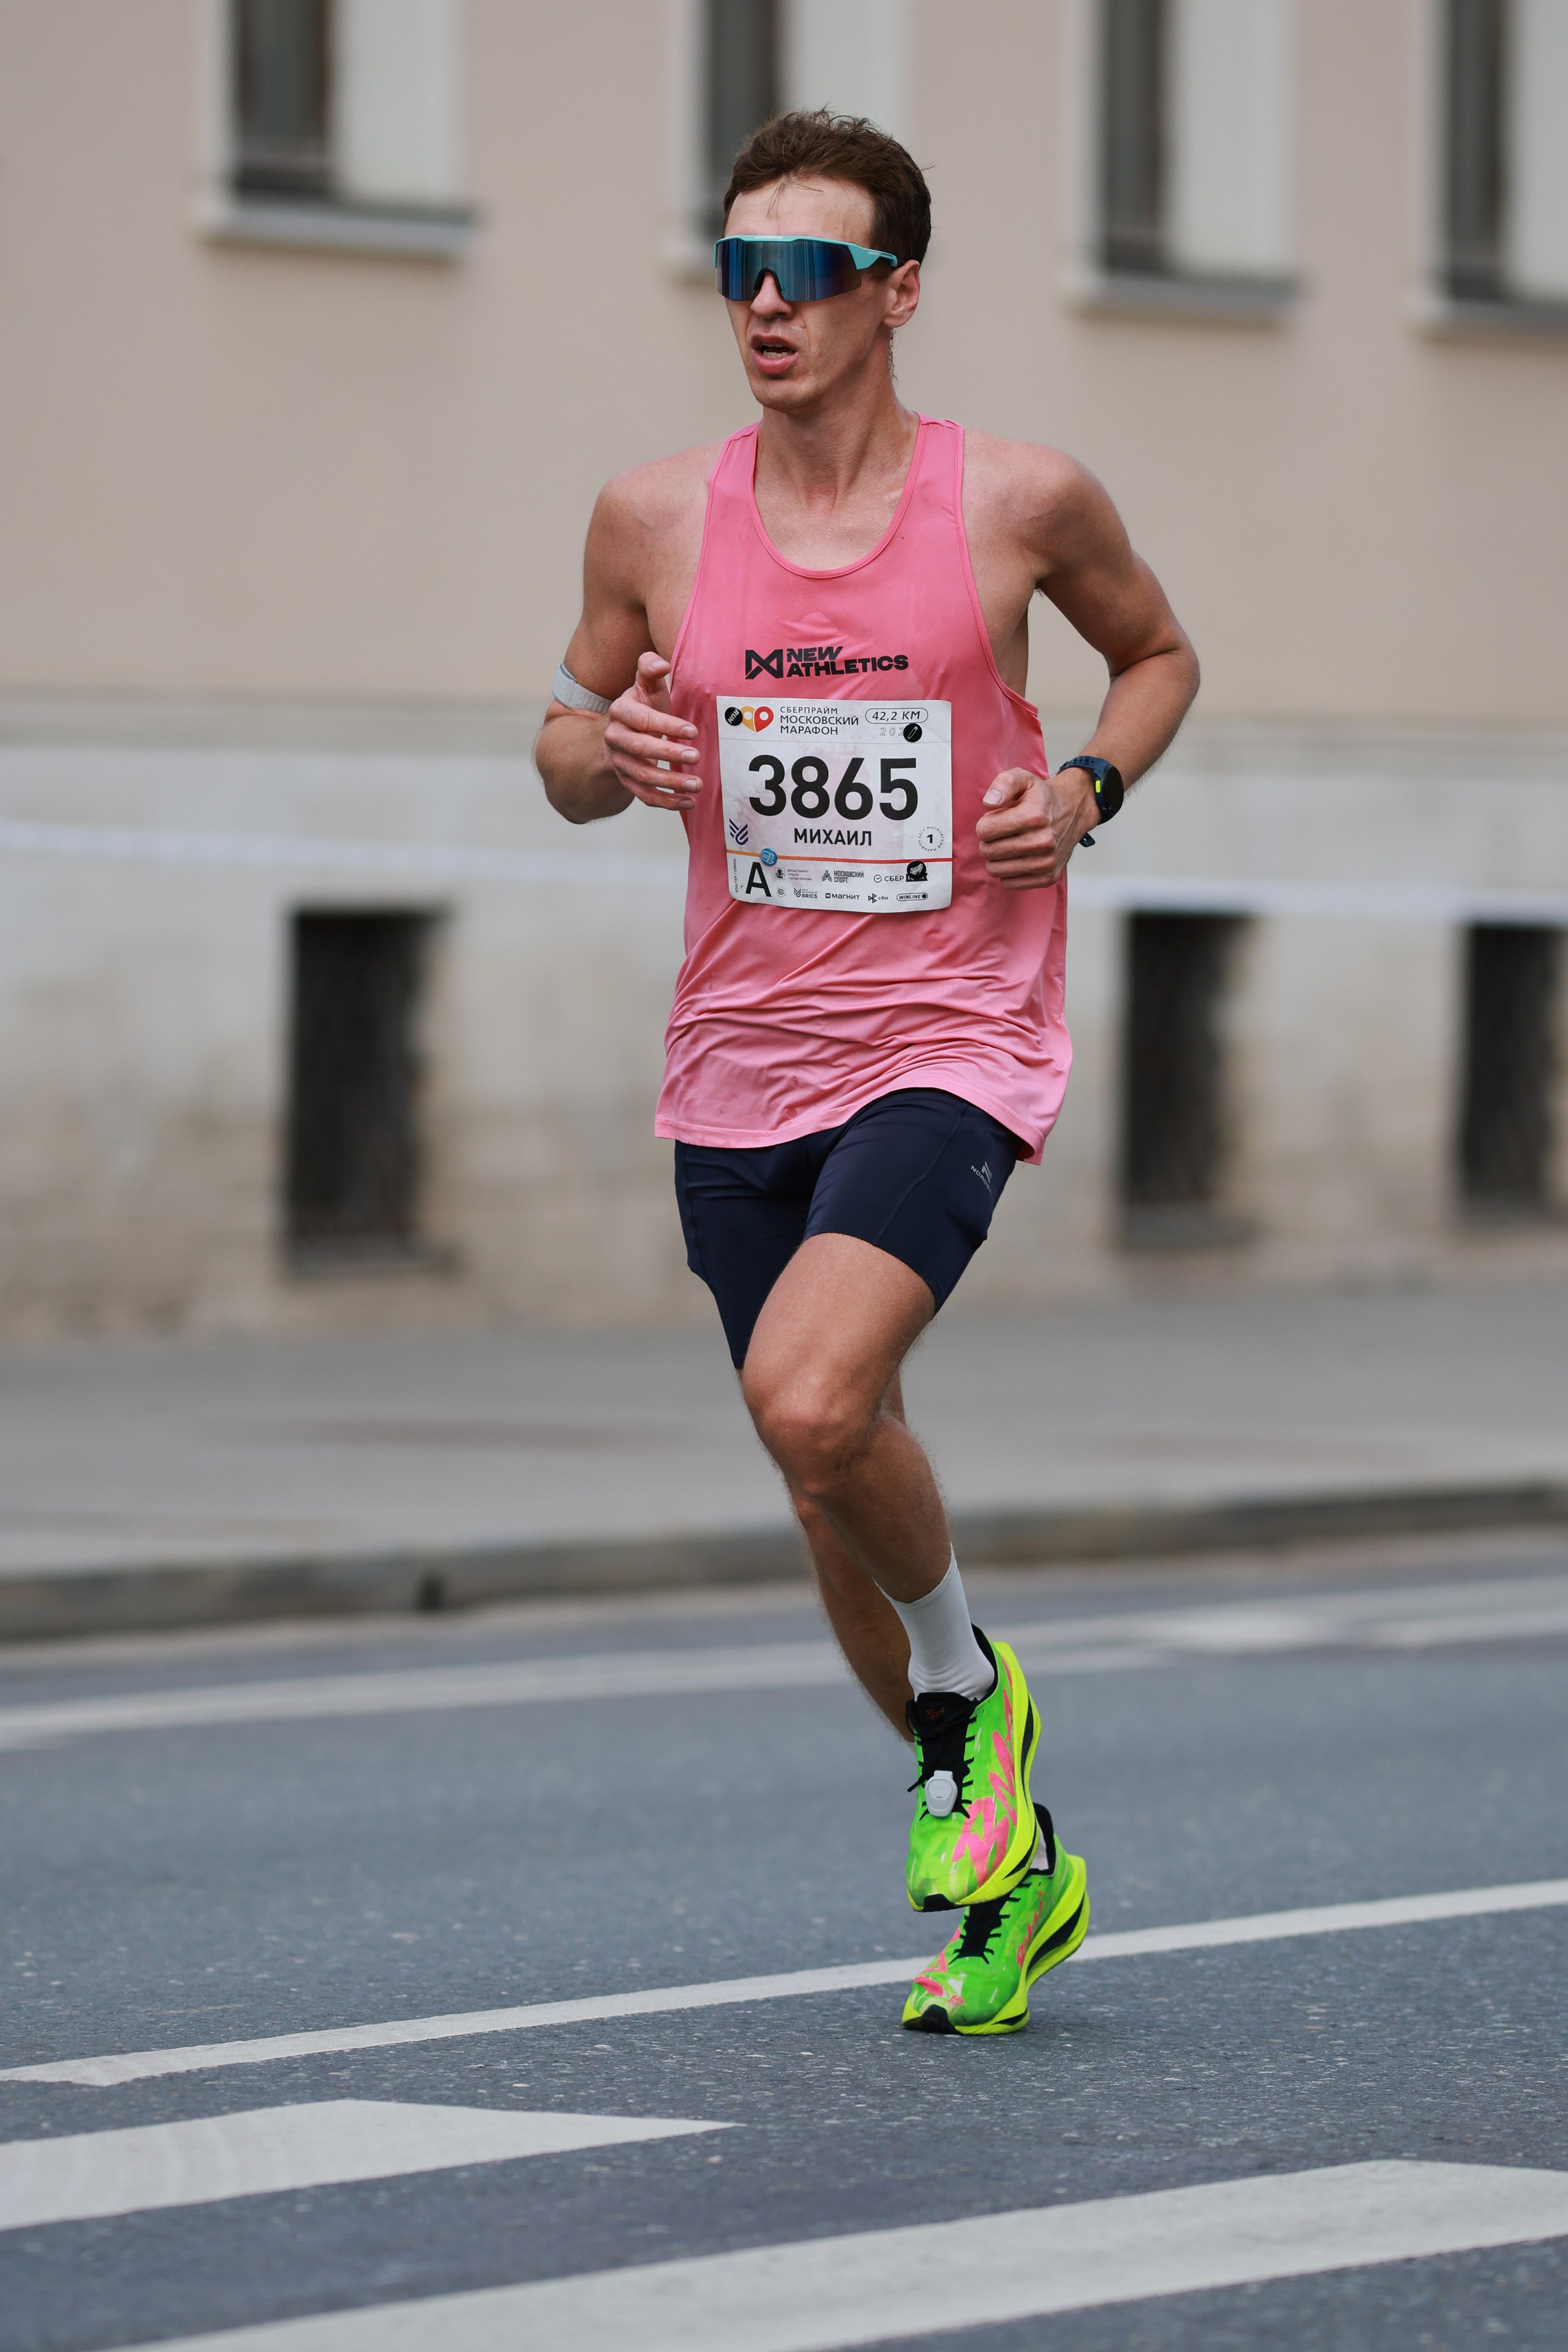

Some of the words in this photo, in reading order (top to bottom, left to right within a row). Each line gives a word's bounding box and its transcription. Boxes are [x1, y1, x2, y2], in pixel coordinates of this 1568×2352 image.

[787, 646, 843, 663] NEW
[786, 655, 909, 677] ATHLETICS
[728, 709, 740, 724] RUN
[780, 715, 859, 725] МОСКОВСКИЙ
[872, 711, 897, 722] 42,2
[780, 725, 839, 735] МАРАФОН
[748, 755, 918, 821] 3865
[794, 827, 872, 846] МИХАИЛ
[927, 834, 933, 843] 1
